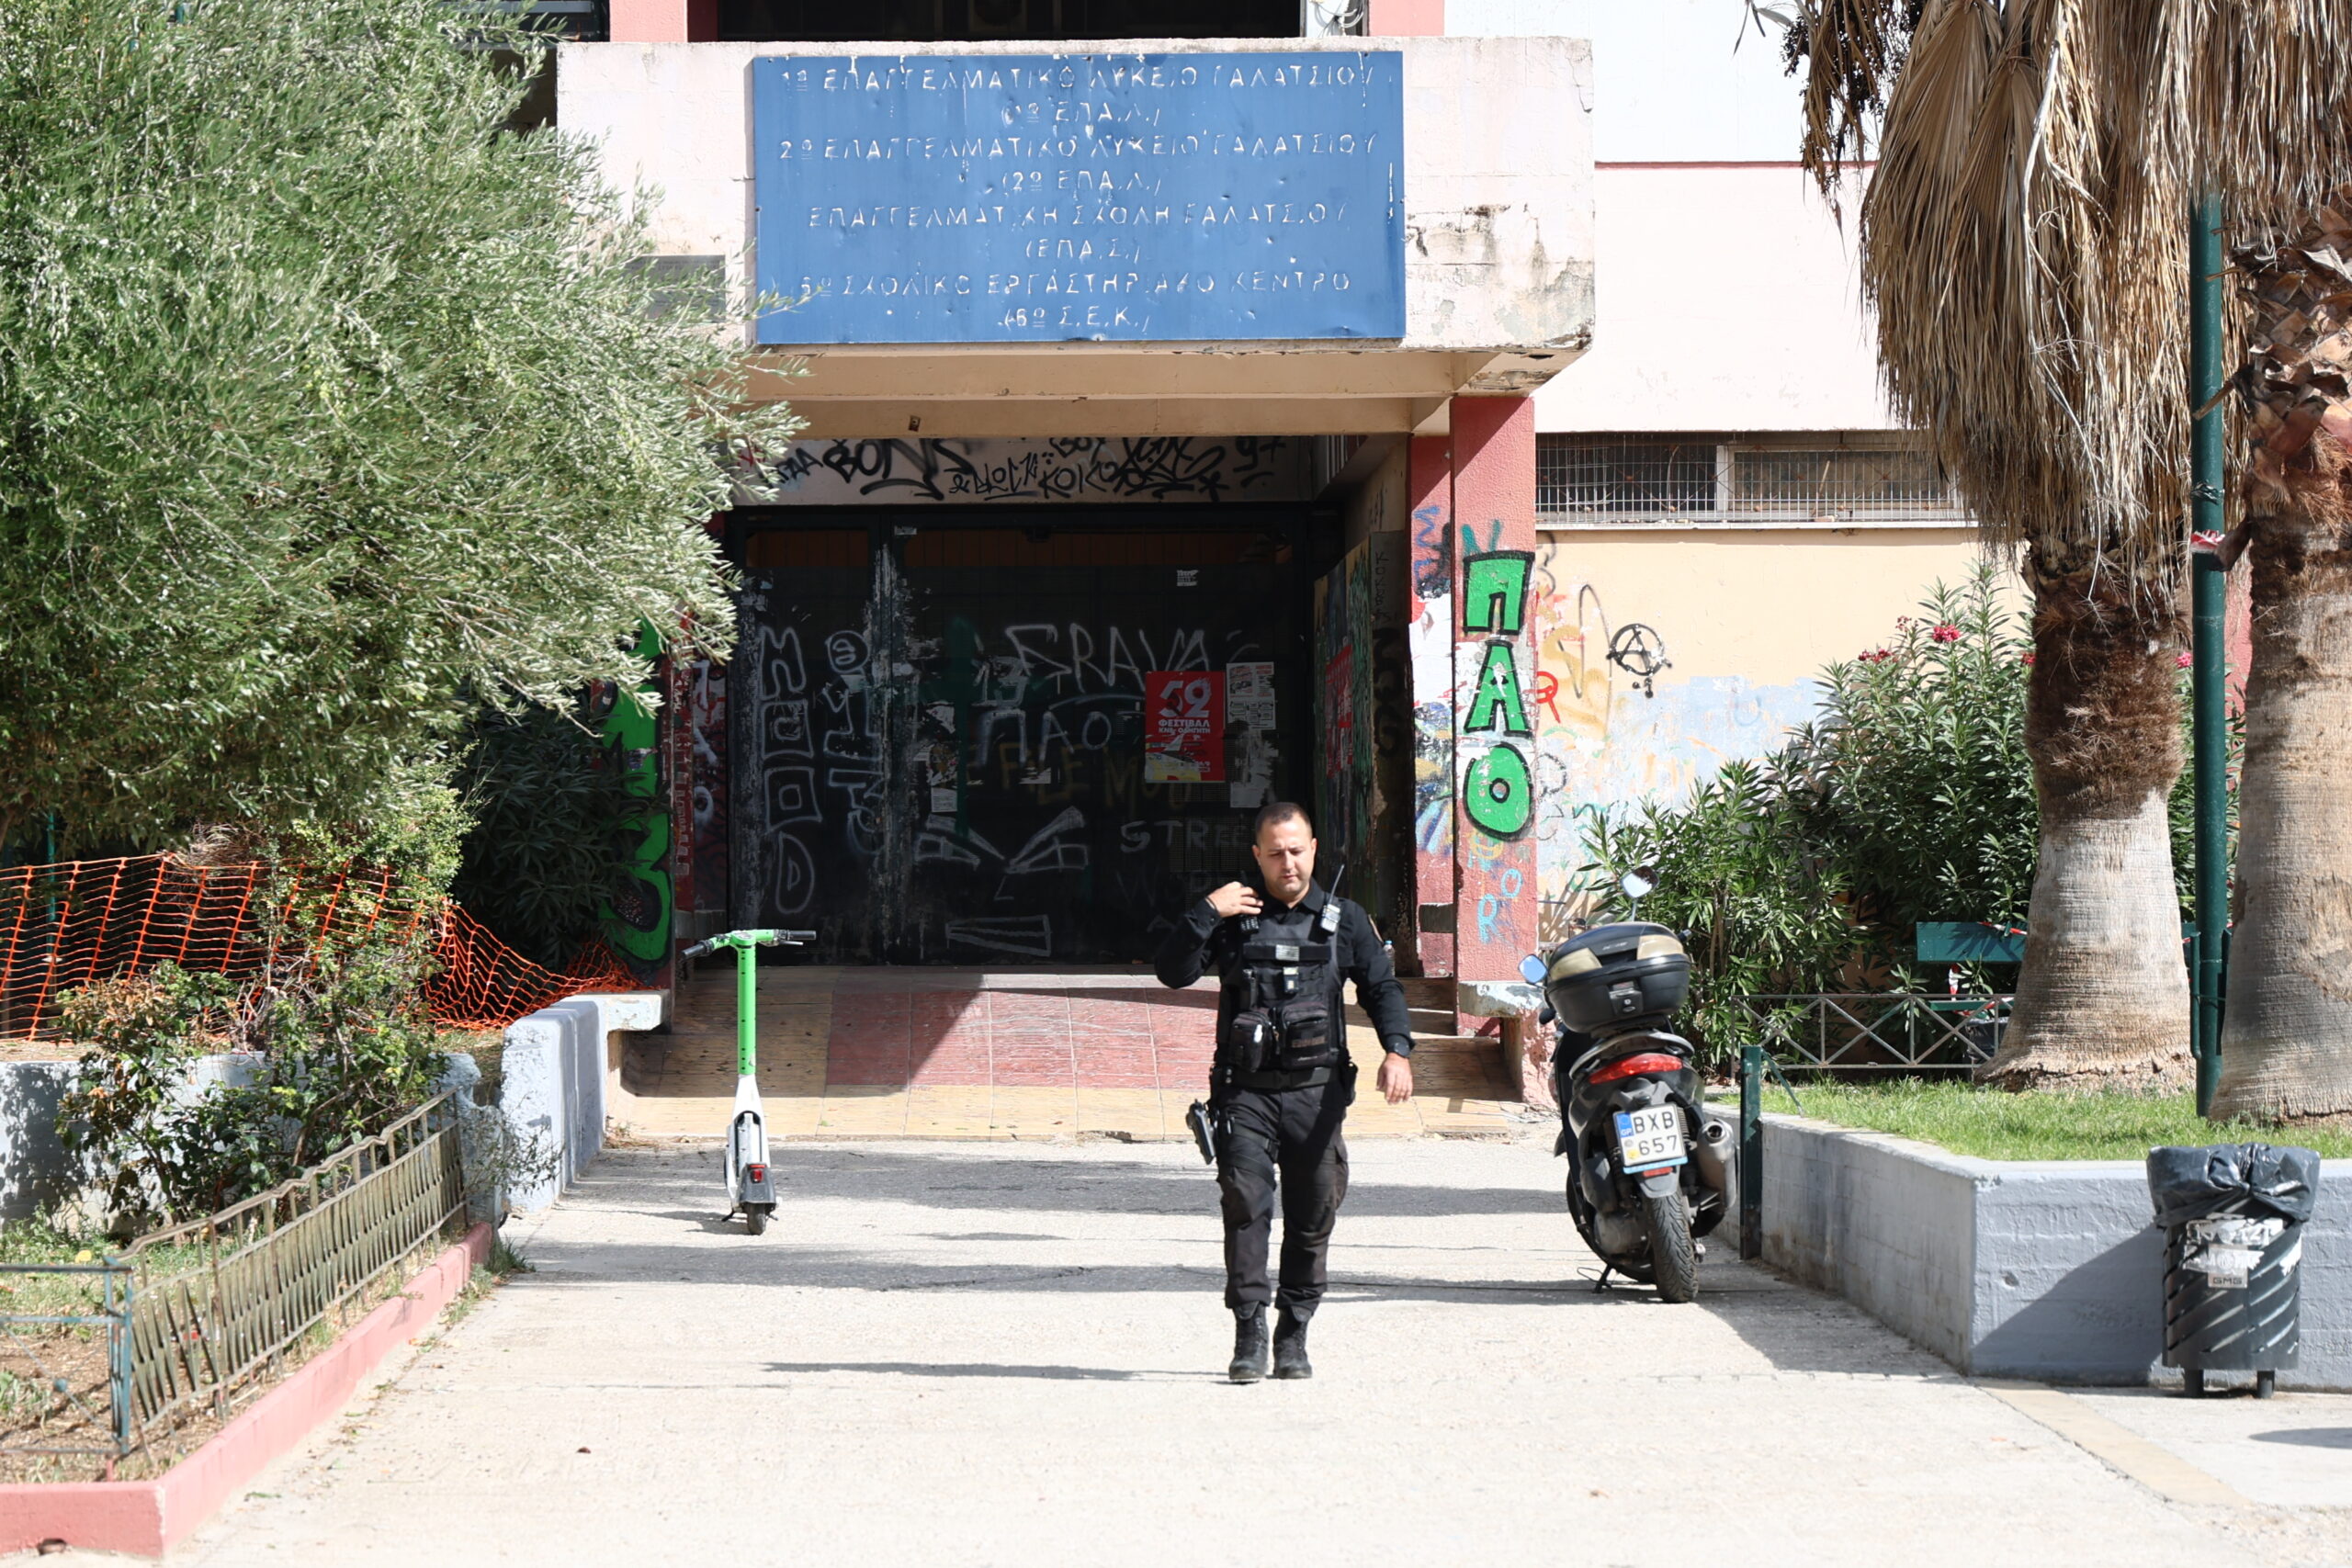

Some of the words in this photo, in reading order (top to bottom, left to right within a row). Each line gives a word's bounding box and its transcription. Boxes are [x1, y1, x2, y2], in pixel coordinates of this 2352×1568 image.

[823, 137, 1078, 162] ΕΠΑΓΓΕΛΜΑΤΙΚΟ
[1090, 136, 1199, 159] ΛΥΚΕΙΟ
[1212, 134, 1377, 157] ΓΑΛΑΤΣΙΟΥ
[808, 206, 1057, 228] ΕΠΑΓΓΕΛΜΑΤΚΗ
[1071, 205, 1170, 226] ΣΧΟΛΗ
[1183, 202, 1347, 226] ΓΑΛΑΤΣΟΥ
[986, 273, 1216, 295] ΕΡΓΑΣΤΗΡΑΚΟ
[1159, 677, 1212, 717] 52
[1158, 719, 1210, 728] ΦΕΣΤΙΒΑΛ
[1638, 1134, 1678, 1156] 657
